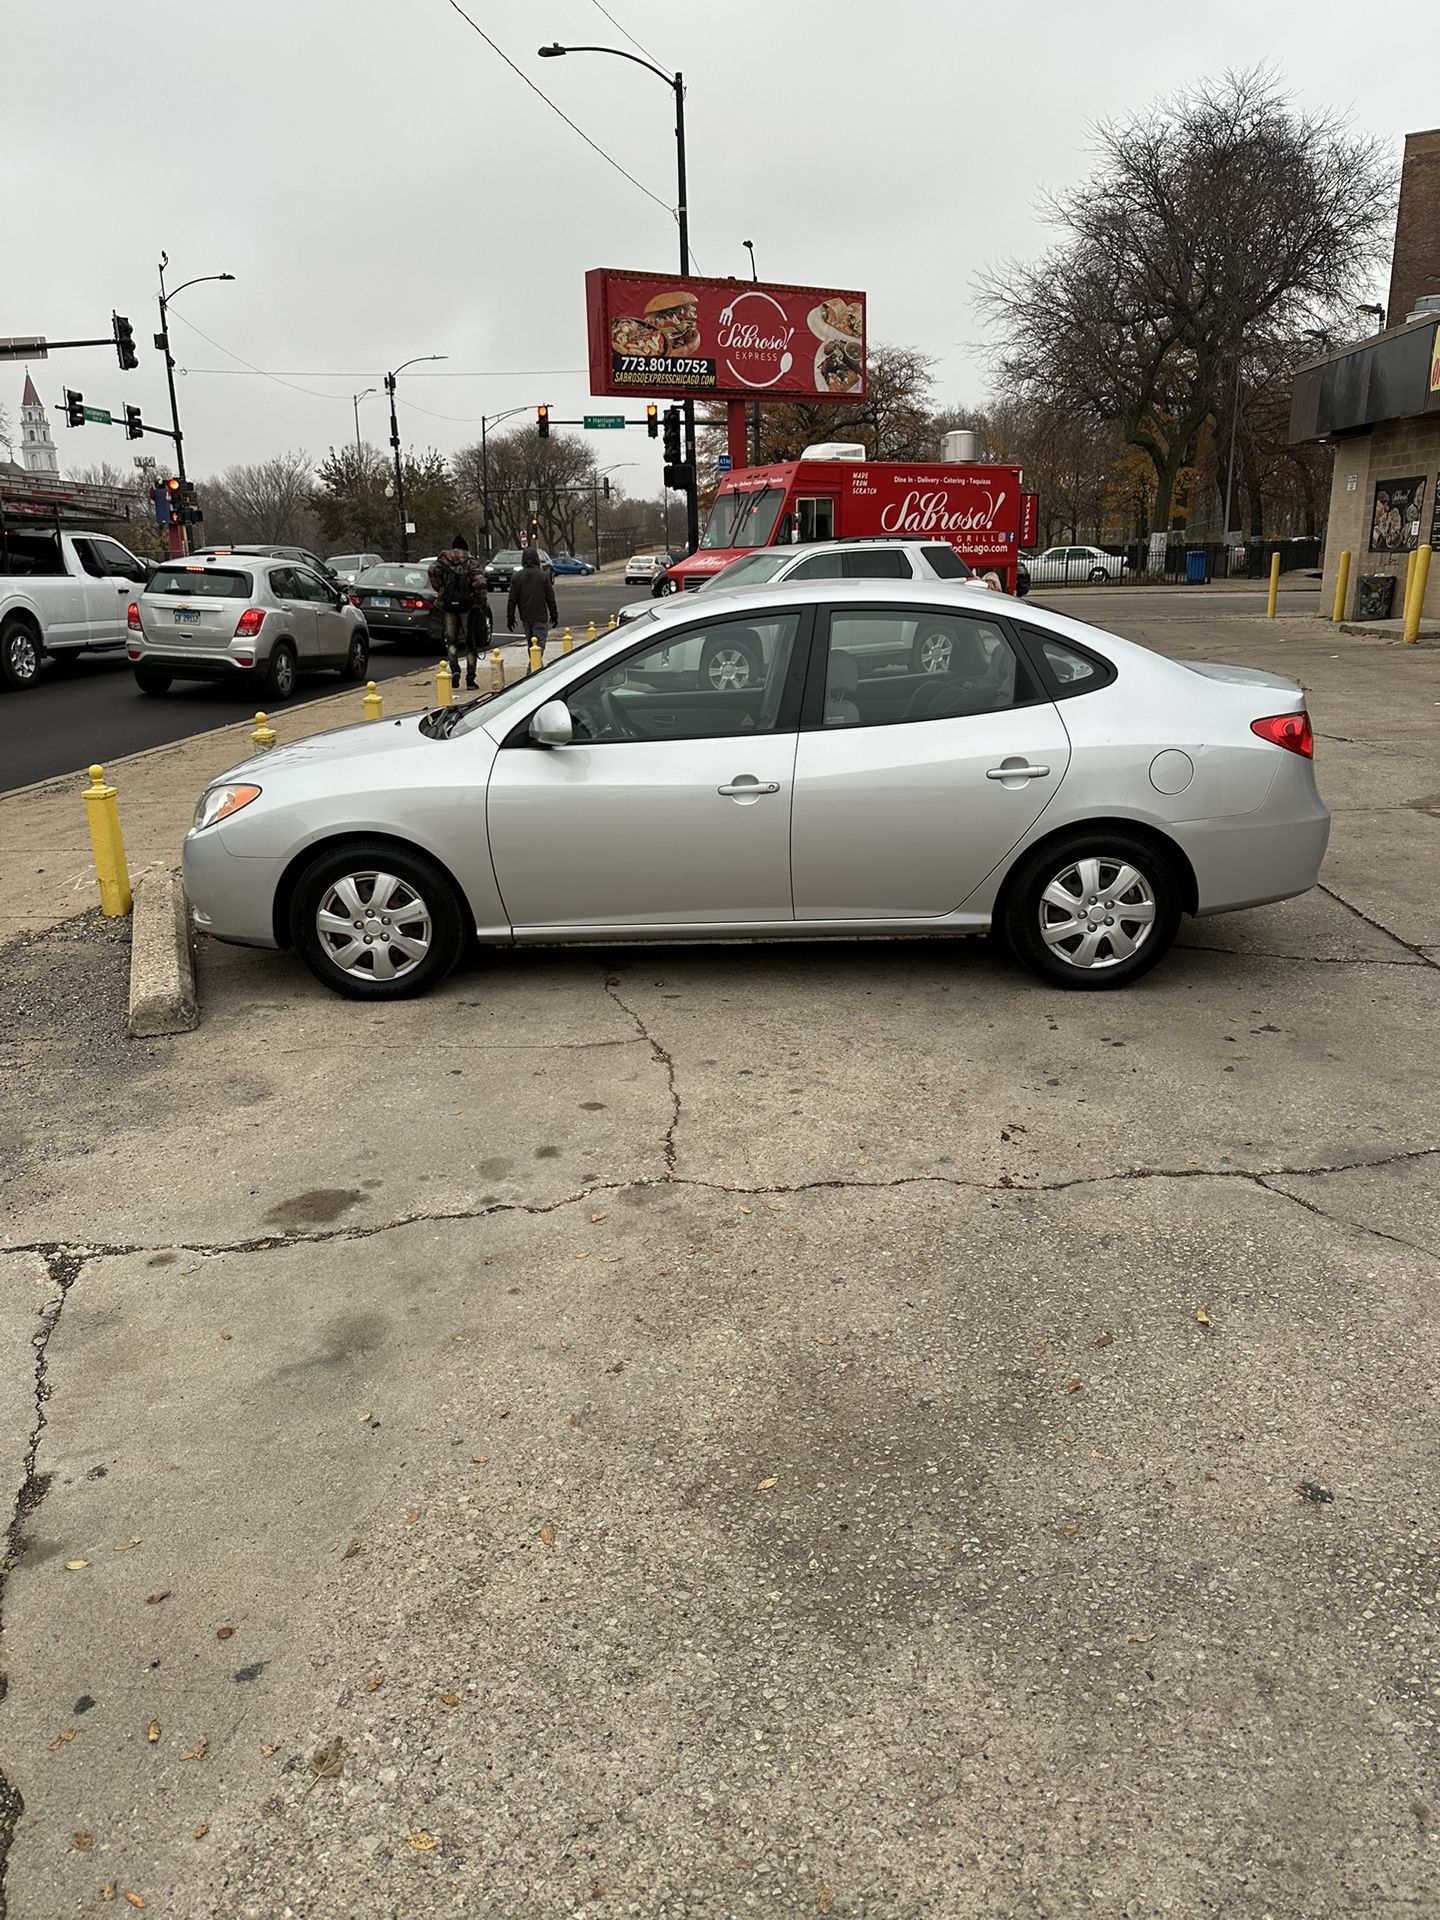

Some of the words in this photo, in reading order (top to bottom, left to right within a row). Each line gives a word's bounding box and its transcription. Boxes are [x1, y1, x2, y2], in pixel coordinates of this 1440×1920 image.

[735, 351, 778, 362] EXPRESS
[621, 356, 708, 373] 773.801.0752
[614, 372, 716, 386] SABROSOEXPRESSCHICAGO.COM
[852, 472, 869, 480] MADE
[917, 476, 940, 485] Delivery
[943, 476, 966, 486] Catering
[969, 477, 992, 486] Taquizas
[852, 487, 877, 495] SCRATCH
[956, 534, 996, 543] GRILL
[952, 542, 1008, 555] ochicago.com
